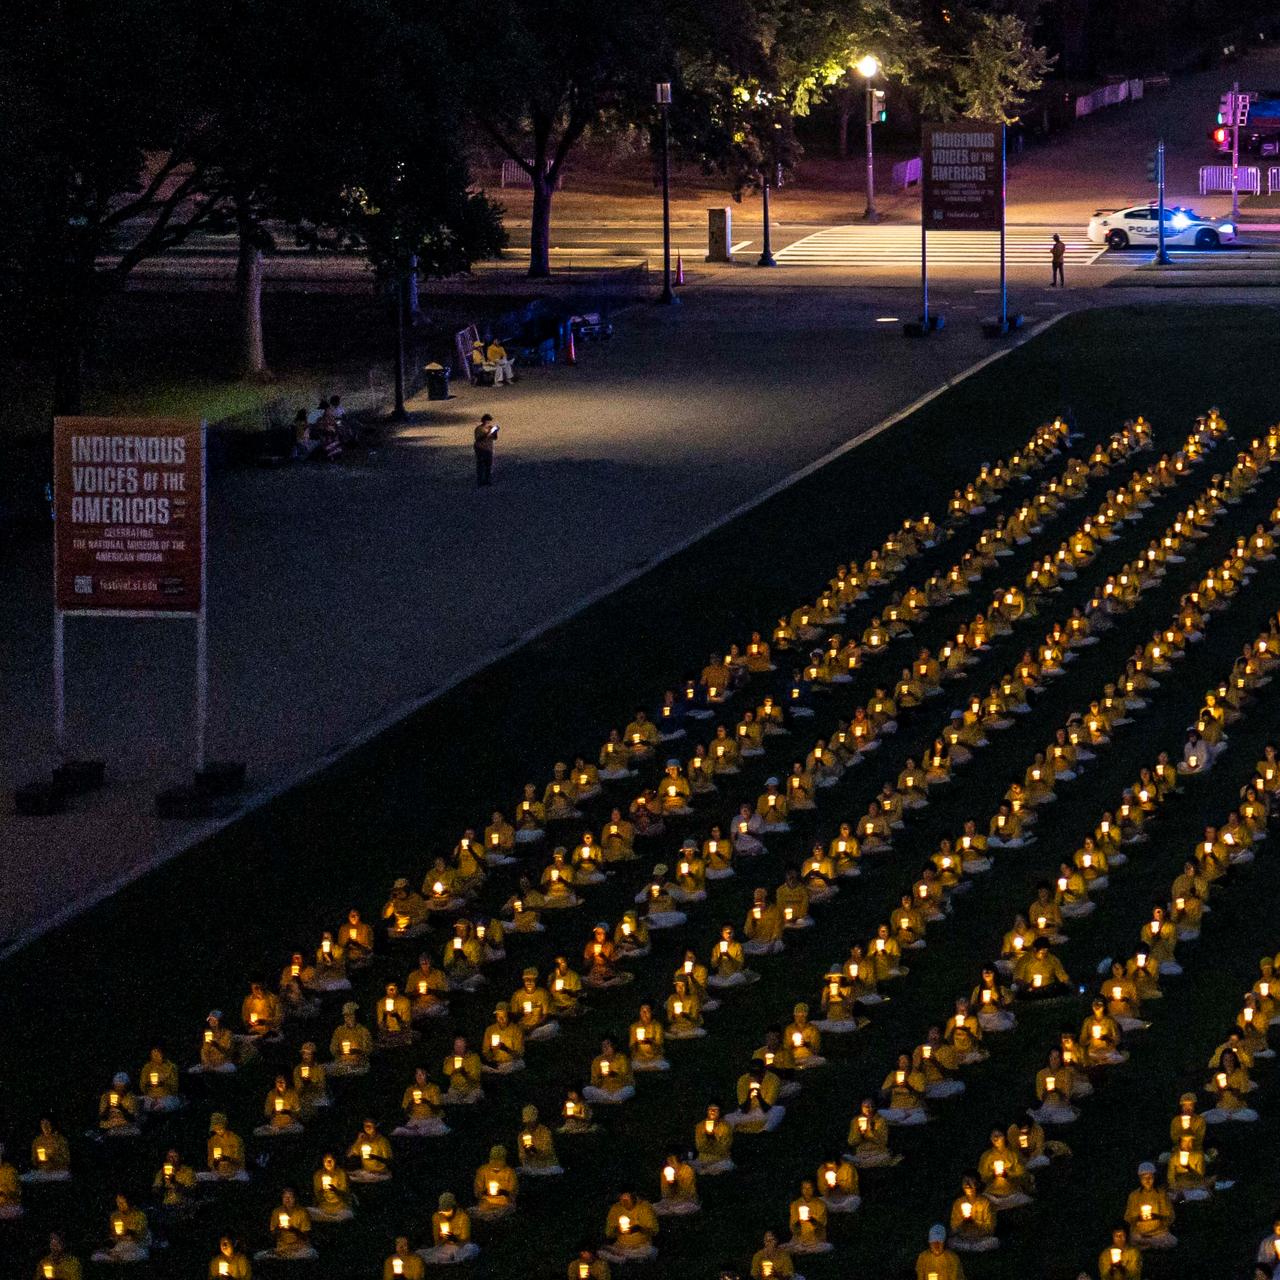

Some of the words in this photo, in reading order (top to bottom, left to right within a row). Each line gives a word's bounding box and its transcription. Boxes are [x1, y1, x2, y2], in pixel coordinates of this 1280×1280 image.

[931, 132, 994, 148] INDIGENOUS
[932, 149, 969, 164] VOICES
[981, 152, 994, 162] THE
[931, 165, 986, 181] AMERICAS
[71, 435, 186, 464] INDIGENOUS
[71, 466, 139, 493] VOICES
[143, 472, 159, 491] OF
[162, 472, 186, 491] THE
[71, 497, 171, 524] AMERICAS
[104, 528, 154, 538] CELEBRATING
[73, 540, 86, 550] THE
[88, 540, 125, 550] NATIONAL
[126, 540, 160, 550] MUSEUM
[161, 540, 170, 550] OF
[172, 540, 186, 551] THE
[95, 551, 135, 562] AMERICAN
[136, 552, 163, 562] INDIAN
[99, 579, 158, 591] festival.si.edu
